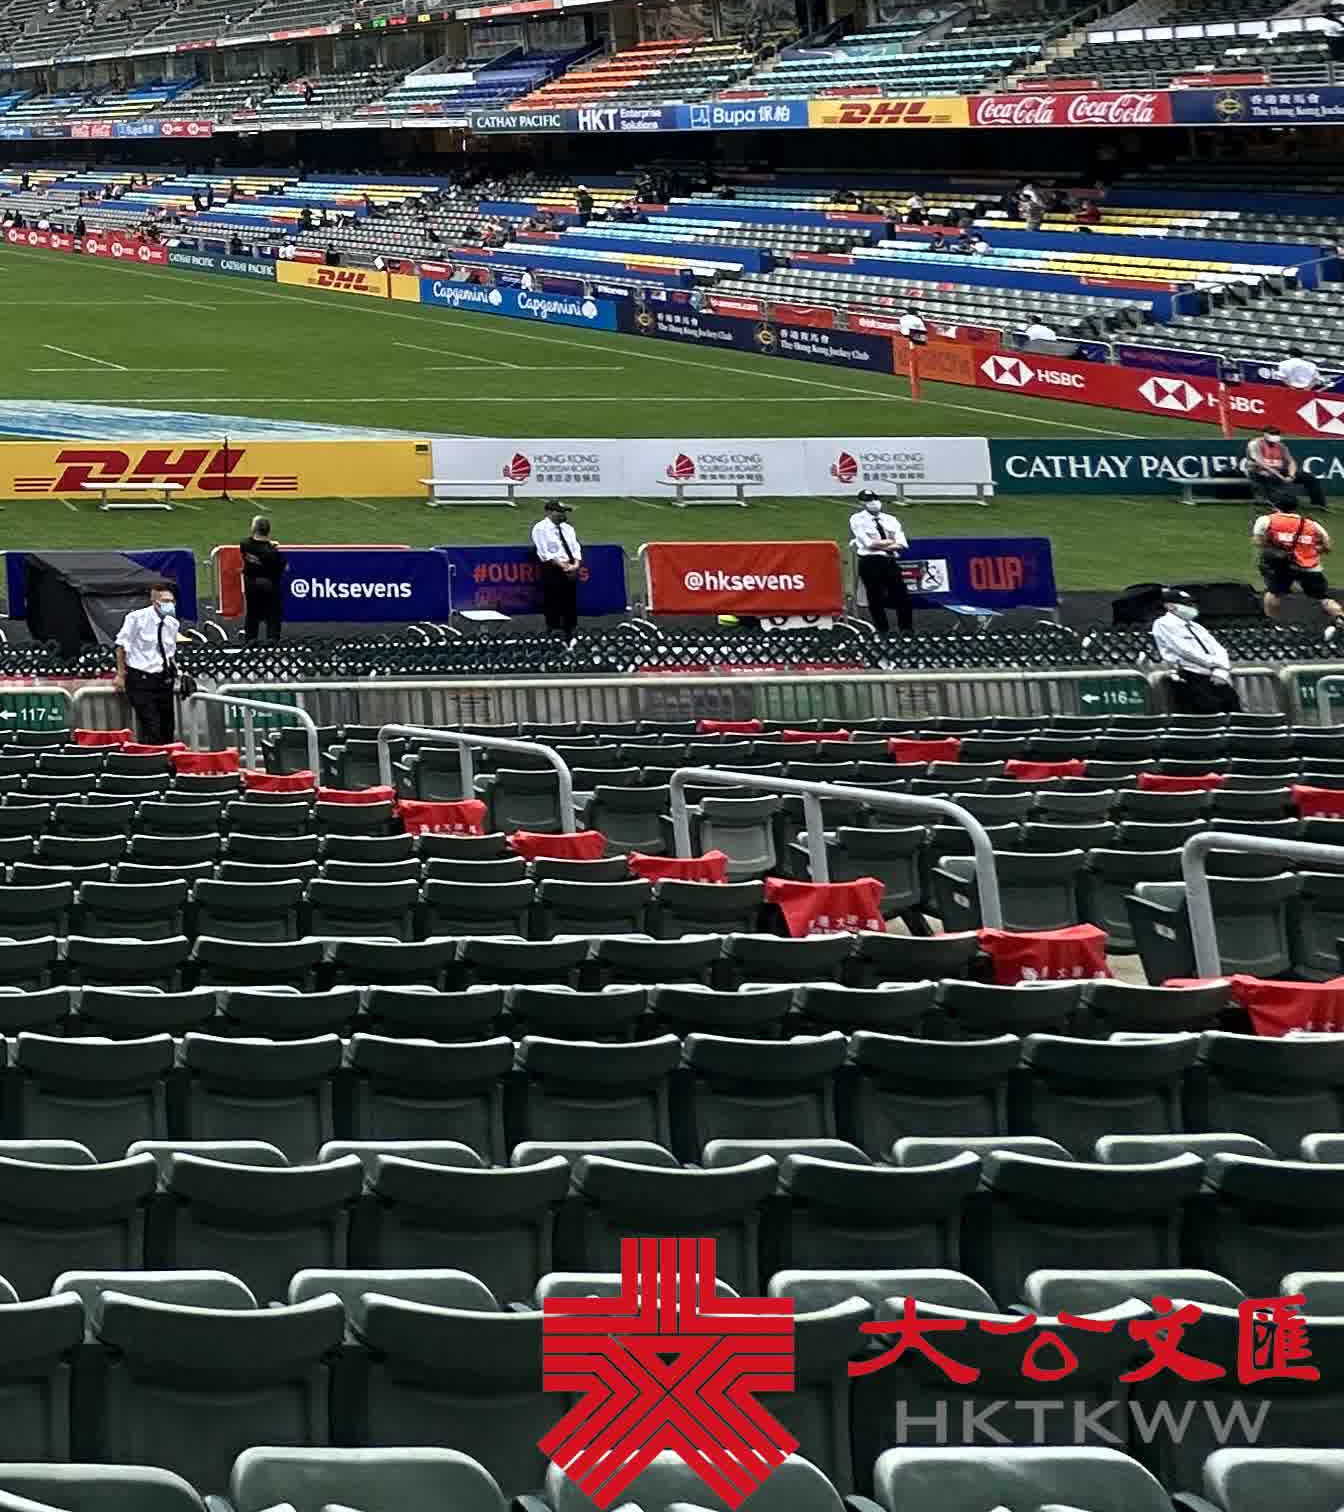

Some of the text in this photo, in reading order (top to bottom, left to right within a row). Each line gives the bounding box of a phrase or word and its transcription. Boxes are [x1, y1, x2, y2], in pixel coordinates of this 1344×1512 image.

[476, 114, 561, 128] CATHAY PACIFIC
[577, 108, 619, 131] HKT
[620, 108, 662, 120] Enterprise
[713, 108, 756, 126] Bupa
[839, 102, 932, 125] DHL
[620, 120, 659, 131] Solutions
[316, 268, 369, 291] DHL
[433, 280, 489, 306] Capgemini
[517, 291, 582, 319] Capgemini
[1036, 369, 1085, 389] HSBC
[533, 454, 599, 463] HONG KONG
[697, 453, 761, 463] HONG KONG
[861, 452, 924, 462] HONG KONG
[1005, 455, 1138, 478] CATHAY
[54, 449, 260, 491] DHL
[684, 570, 805, 593] @hksevens
[969, 557, 1024, 591] OUR
[290, 577, 412, 600] @hksevens
[1103, 691, 1128, 705] 116
[20, 707, 46, 723] 117
